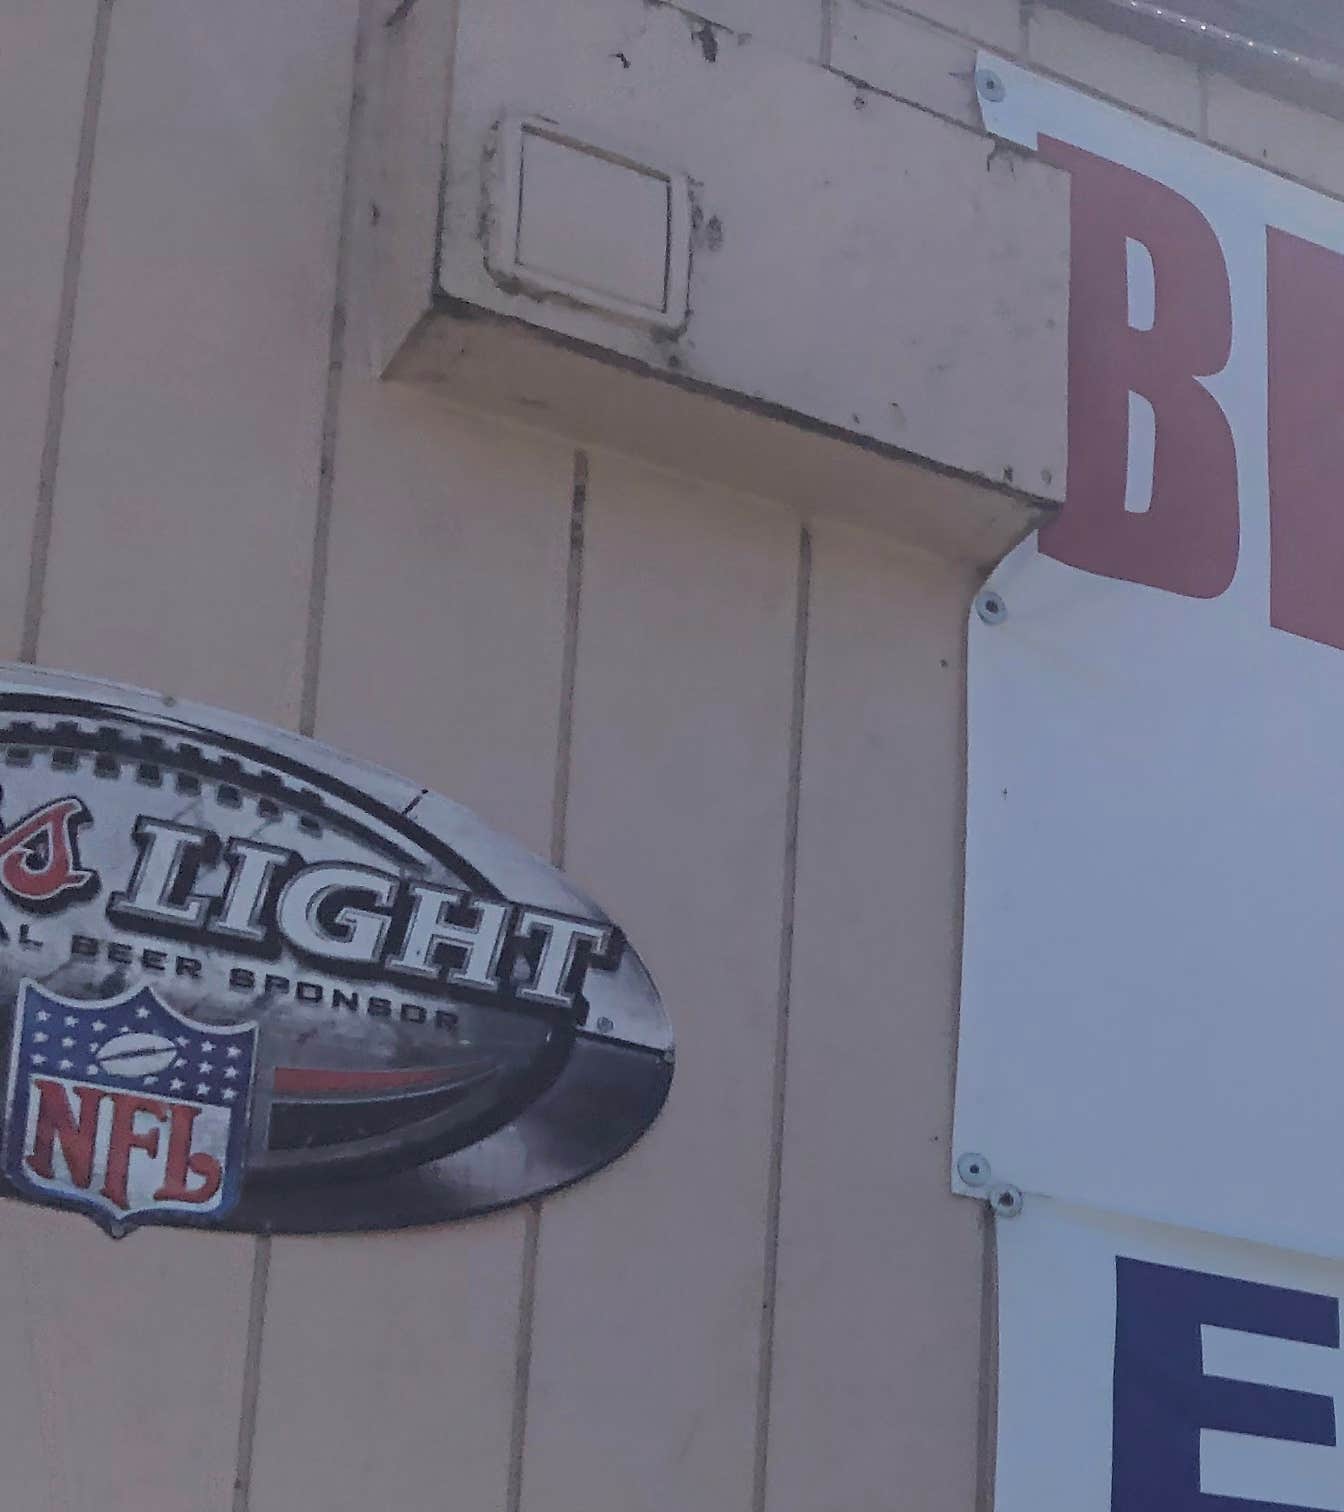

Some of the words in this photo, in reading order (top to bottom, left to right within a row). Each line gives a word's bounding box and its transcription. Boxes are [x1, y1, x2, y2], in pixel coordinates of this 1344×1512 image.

[108, 815, 612, 1008] LIGHT
[71, 934, 203, 980] BEER
[229, 966, 460, 1032] SPONSOR
[24, 1078, 223, 1211] NFL
